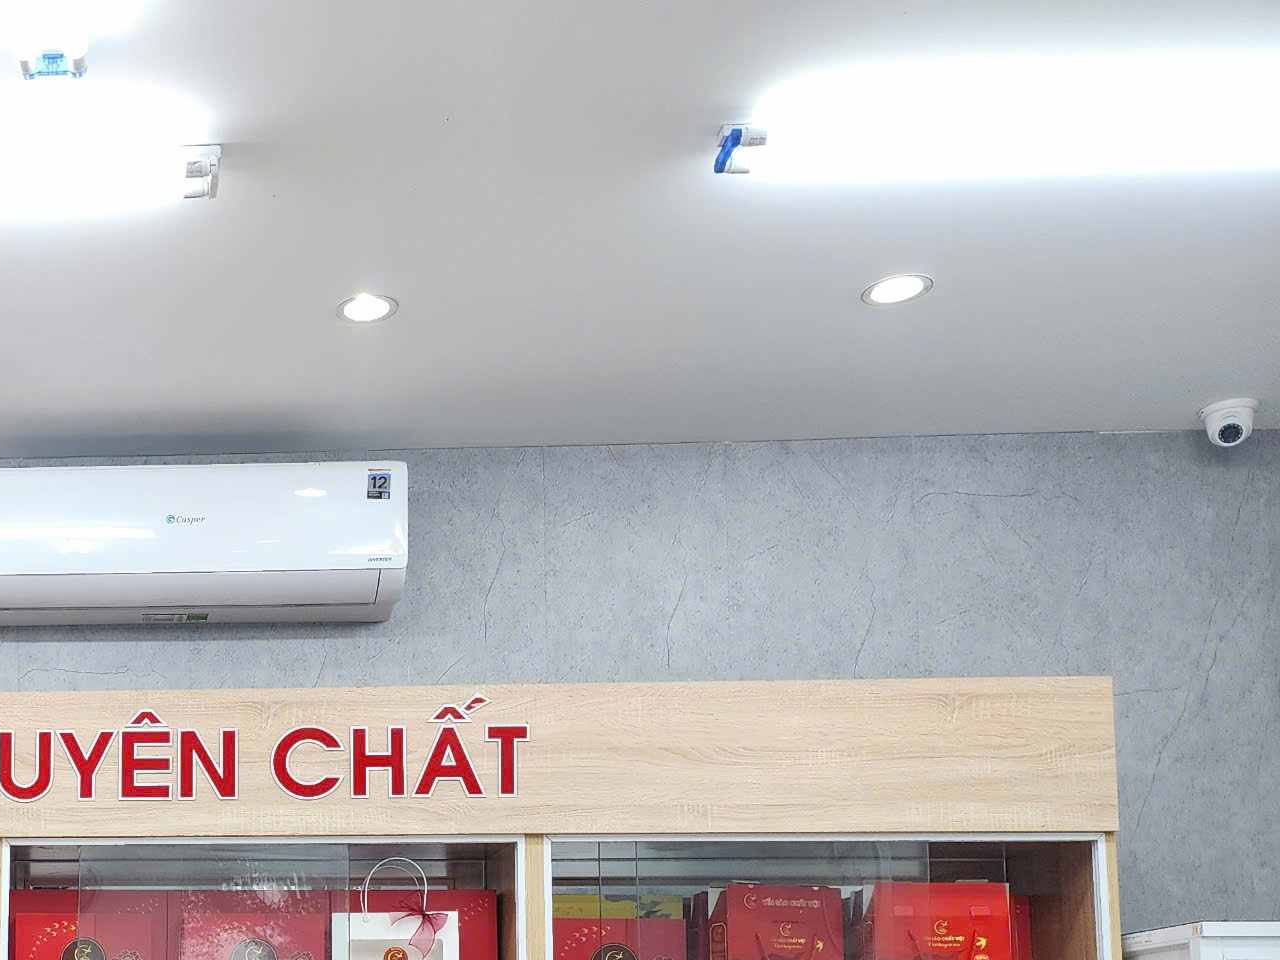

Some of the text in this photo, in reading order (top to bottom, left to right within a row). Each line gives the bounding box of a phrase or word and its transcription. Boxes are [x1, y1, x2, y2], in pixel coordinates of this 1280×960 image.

[371, 476, 388, 490] 12
[176, 515, 206, 525] Casper
[270, 693, 531, 801] CHẤT
